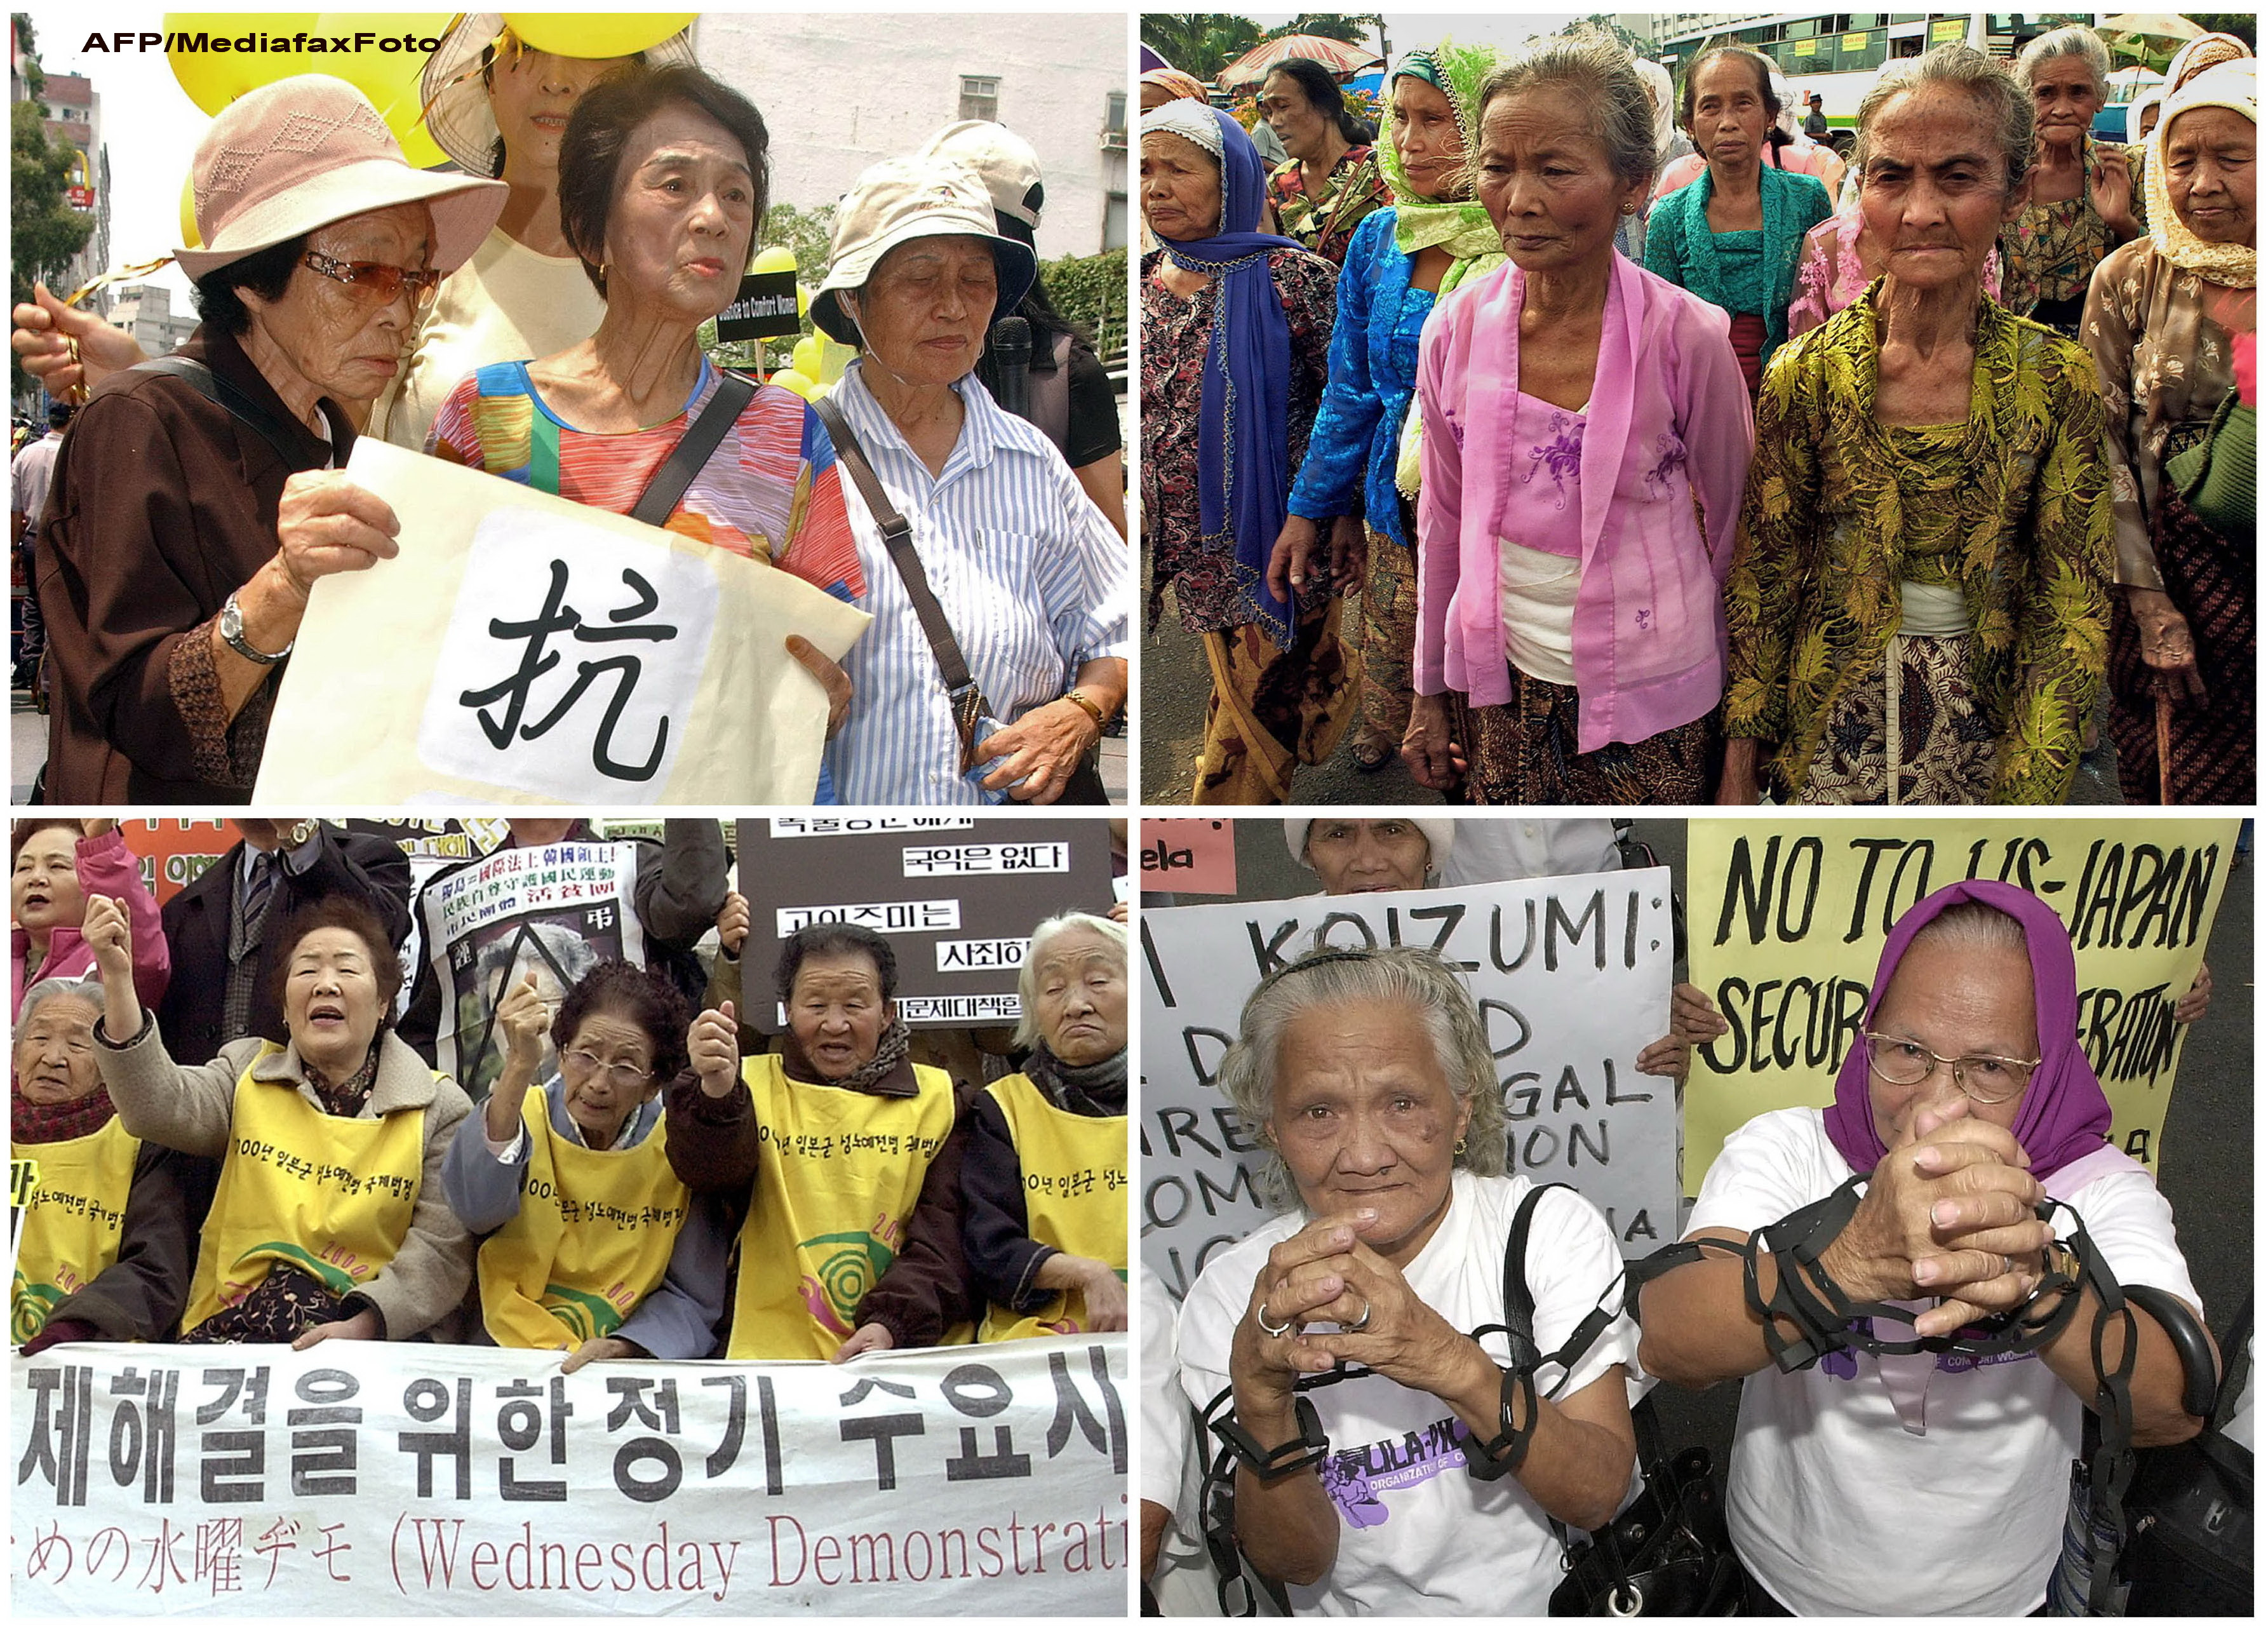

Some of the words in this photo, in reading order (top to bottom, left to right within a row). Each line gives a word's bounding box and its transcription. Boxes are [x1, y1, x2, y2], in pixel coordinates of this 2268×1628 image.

[459, 559, 678, 781] 抗
[905, 847, 993, 872] 국익은
[1000, 845, 1063, 869] 없다
[1713, 835, 1823, 946] NO
[1843, 838, 1934, 945] TO
[785, 904, 952, 934] 고이즈미는
[897, 996, 1022, 1019] 문제대책협
[365, 1174, 415, 1201] 국제법정
[319, 1240, 368, 1277] 2000
[18, 1364, 363, 1506] 제해결을
[398, 1376, 574, 1502] 위한
[607, 1375, 783, 1503] 정기
[1370, 1463, 1433, 1491] ORGANIZATI
[391, 1510, 741, 1602] (Wednesday
[765, 1493, 1127, 1587] Demonstrati
